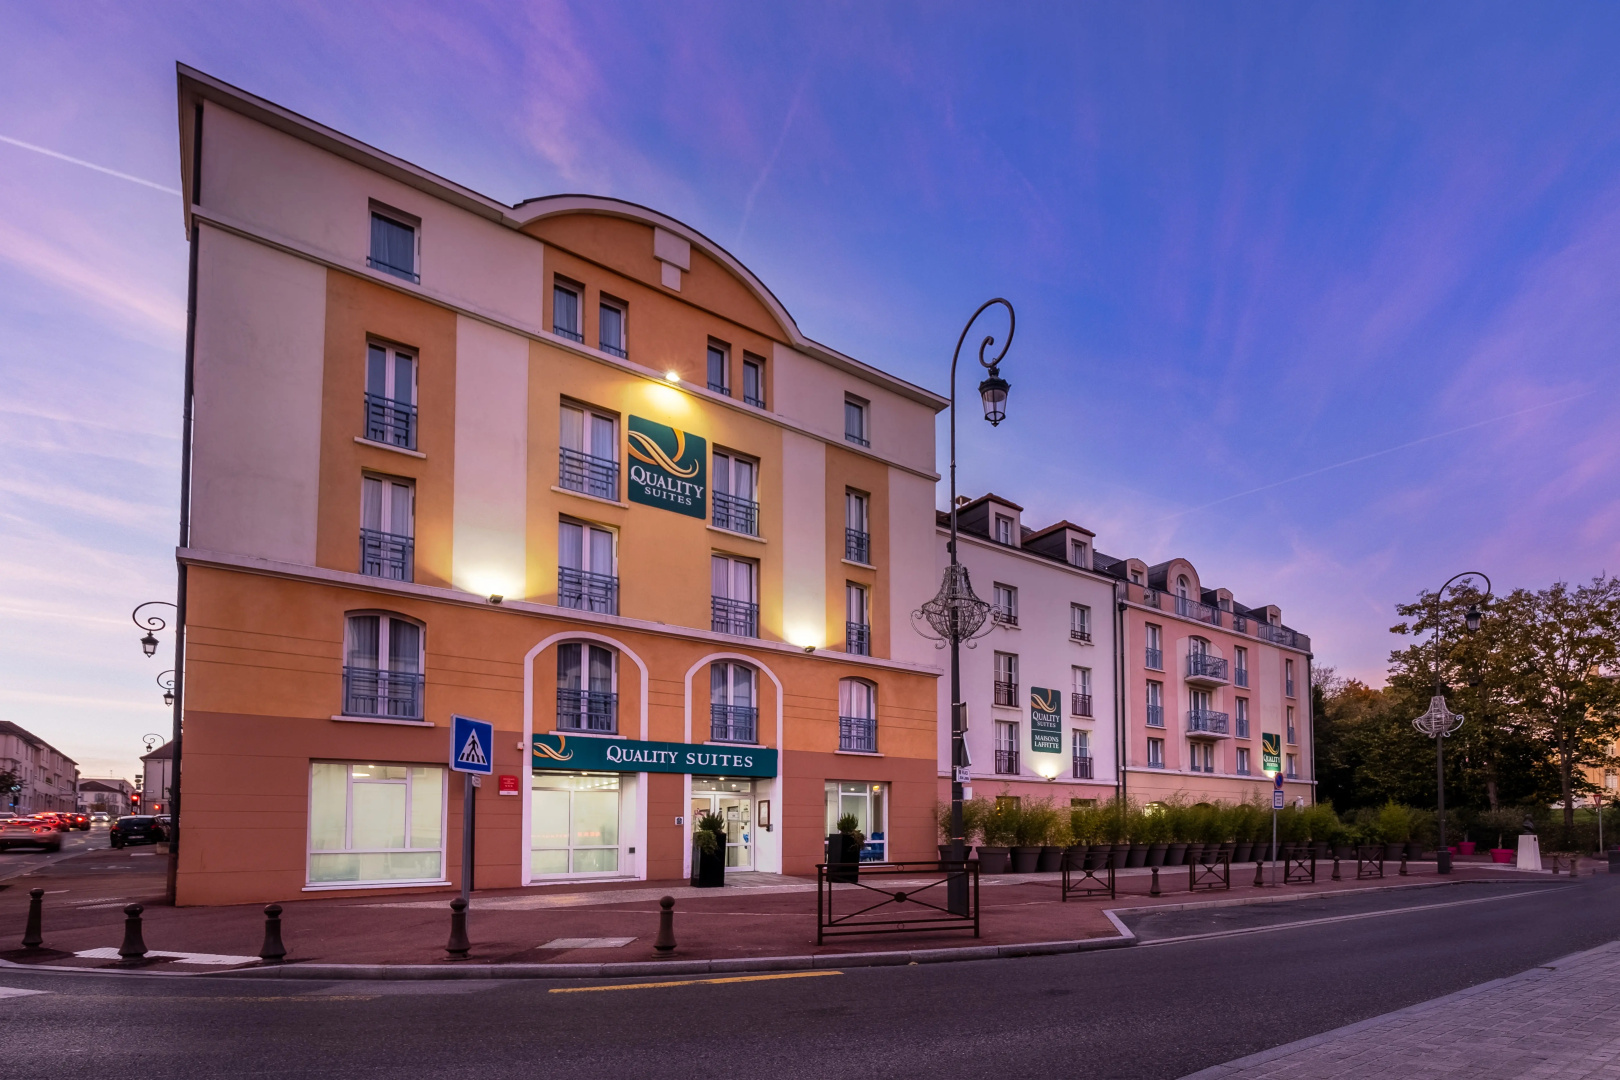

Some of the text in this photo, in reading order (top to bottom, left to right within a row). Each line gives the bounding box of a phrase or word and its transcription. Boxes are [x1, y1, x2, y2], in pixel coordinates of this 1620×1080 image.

[630, 465, 704, 499] QUALITY
[644, 486, 692, 506] SUITES
[1032, 710, 1060, 723] QUALITY
[1036, 720, 1056, 728] SUITES
[1034, 734, 1059, 743] MAISONS
[1034, 740, 1060, 749] LAFFITTE
[606, 745, 753, 768] QUALITY SUITES
